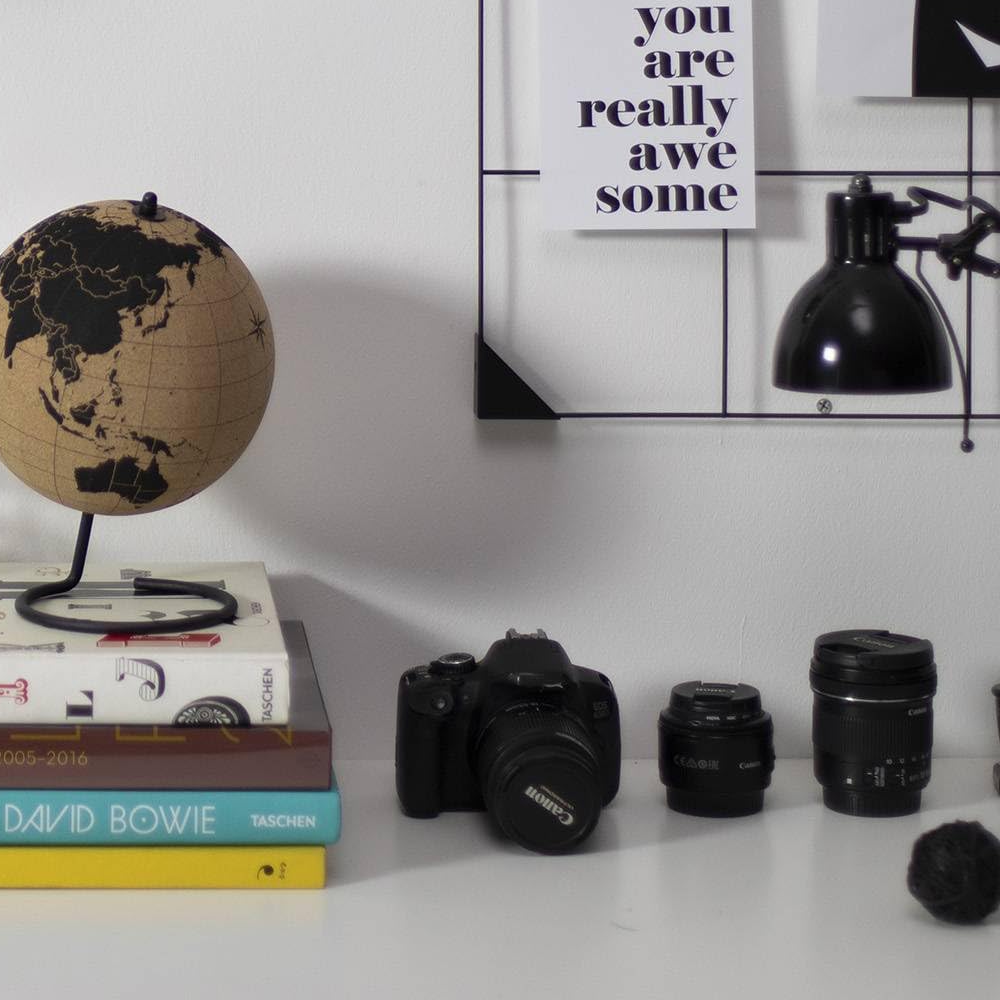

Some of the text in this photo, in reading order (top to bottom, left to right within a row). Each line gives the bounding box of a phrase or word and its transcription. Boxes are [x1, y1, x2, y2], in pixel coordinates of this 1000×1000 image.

[633, 5, 735, 48] you
[643, 49, 735, 79] are
[577, 84, 737, 138] really
[628, 141, 737, 172] awe
[595, 183, 738, 214] some
[259, 668, 276, 723] TASCHEN
[4, 802, 95, 833] DAVID
[110, 803, 216, 835] BOWIE
[250, 813, 317, 828] TASCHEN
[524, 785, 574, 826] Canon
